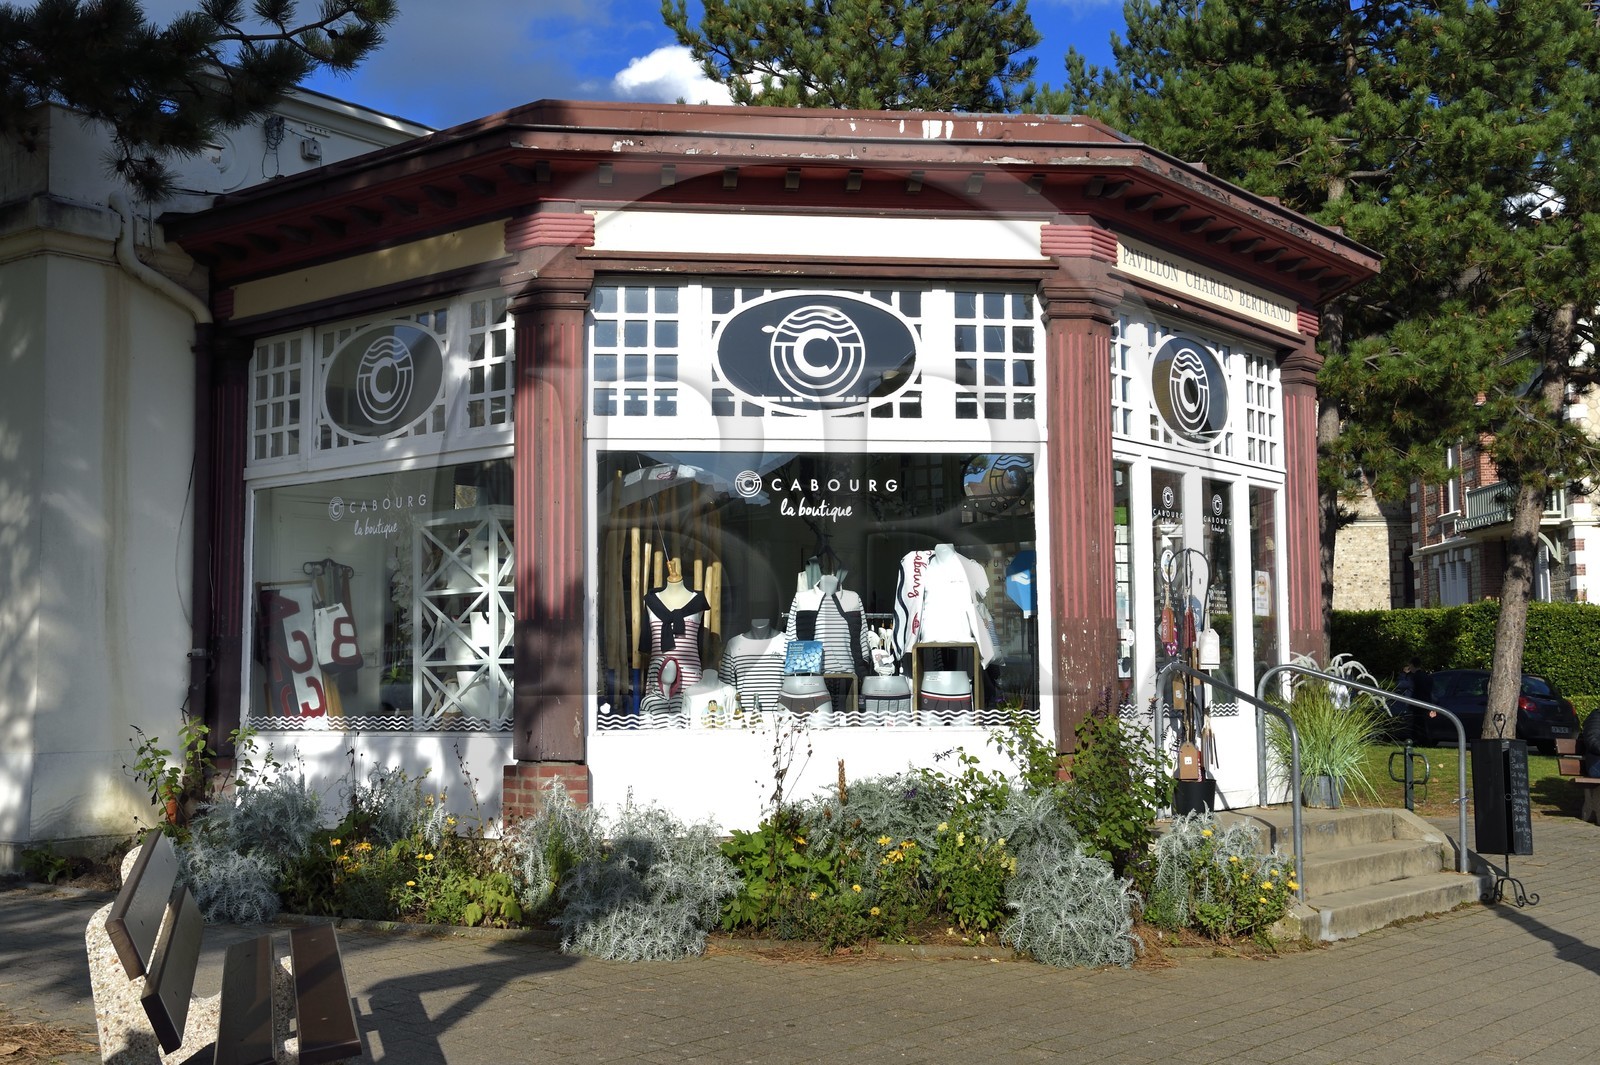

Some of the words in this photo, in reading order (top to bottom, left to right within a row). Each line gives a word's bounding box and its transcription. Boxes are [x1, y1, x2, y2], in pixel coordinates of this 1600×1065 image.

[1123, 246, 1179, 282] PAVILLON
[1185, 268, 1234, 303] CHARLES
[1239, 288, 1292, 323] BERTRAND
[771, 478, 898, 492] CABOURG
[349, 494, 427, 513] CABOURG
[780, 498, 796, 516] la
[798, 496, 853, 523] boutique
[1153, 508, 1184, 520] CABOURG
[1203, 515, 1232, 526] CABOURG
[354, 519, 363, 536] la
[364, 516, 398, 539] boutique
